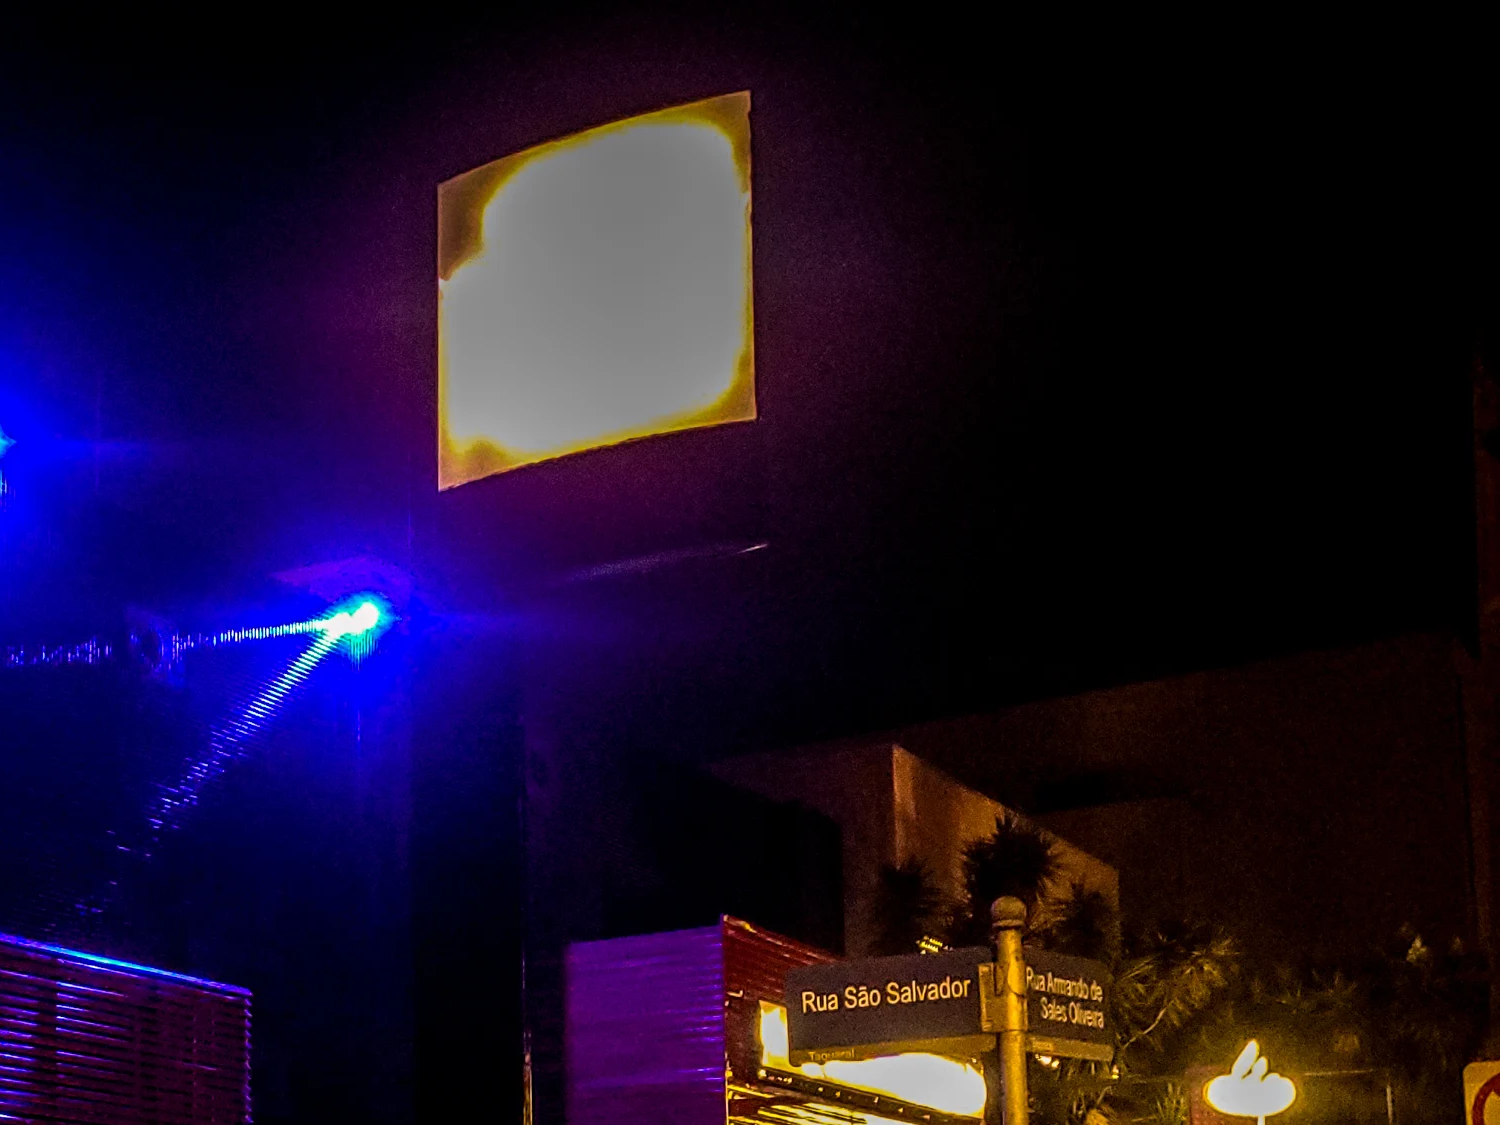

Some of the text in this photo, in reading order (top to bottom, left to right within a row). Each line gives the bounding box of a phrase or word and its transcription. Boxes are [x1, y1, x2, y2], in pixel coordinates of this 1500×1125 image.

[801, 976, 971, 1013] Rua São Salvador
[1025, 966, 1103, 1002] Rua Armando de
[1041, 997, 1104, 1029] Sales Oliveira
